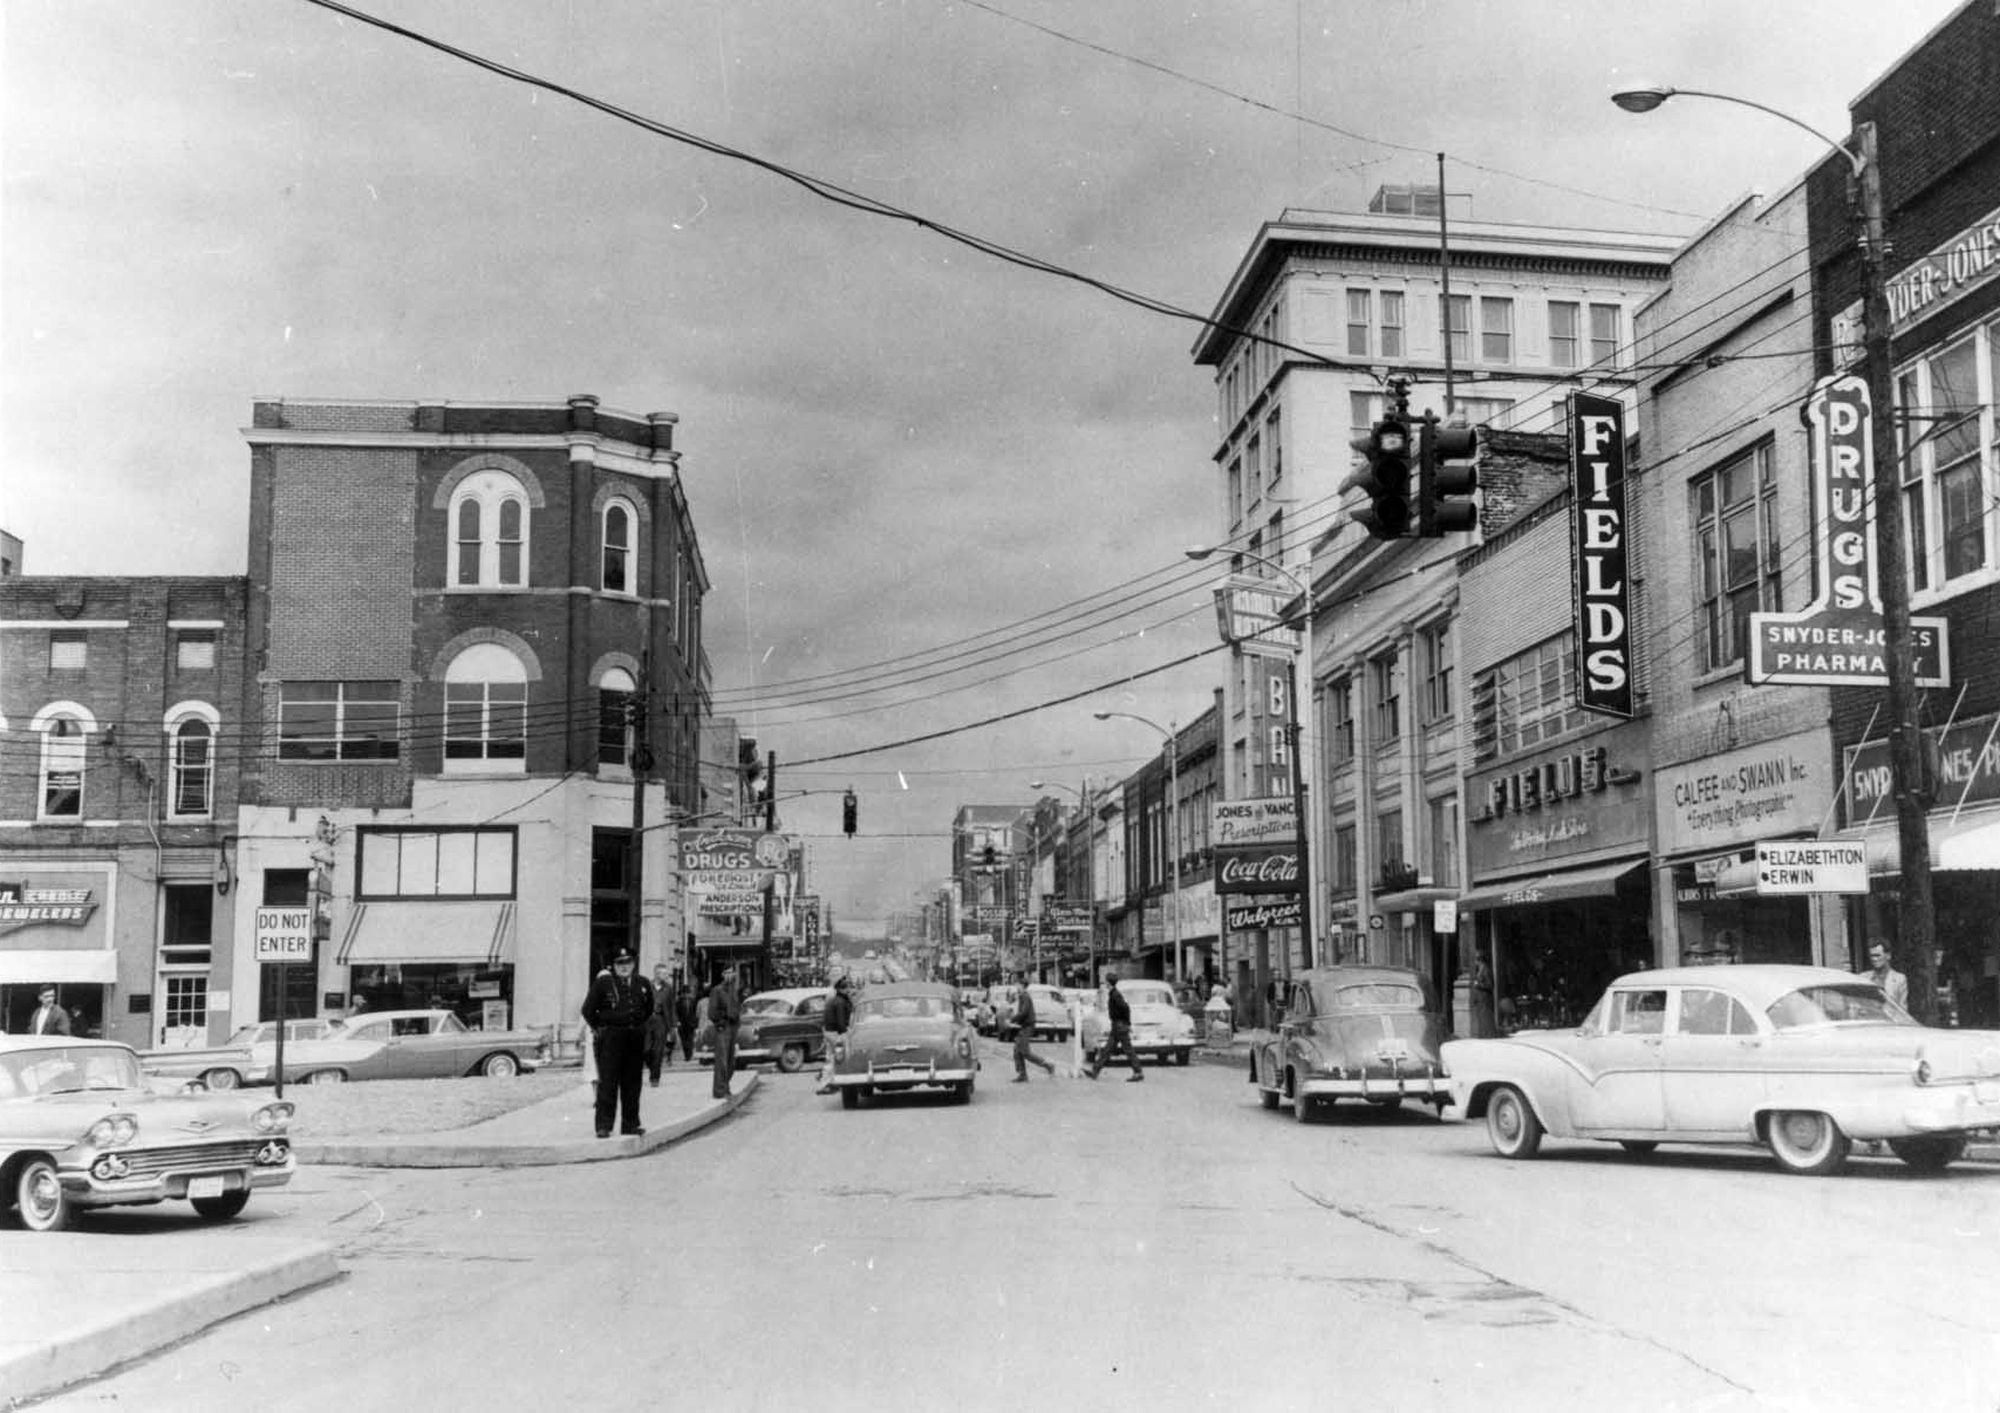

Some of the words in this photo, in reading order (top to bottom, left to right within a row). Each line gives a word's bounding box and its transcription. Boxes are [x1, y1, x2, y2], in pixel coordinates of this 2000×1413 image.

[1886, 217, 2000, 325] YDER-JONES
[1829, 402, 1864, 609] DRUGS
[1580, 415, 1627, 692] FIELDS
[1768, 627, 1932, 647] SNYDER-JOS
[1777, 653, 1923, 673] PHARMAY
[1488, 747, 1606, 819] FIELDS
[1674, 774, 1719, 807] CALFEE
[1721, 774, 1737, 791] AND
[1738, 758, 1786, 795] SWANN
[1216, 805, 1254, 819] JONES
[685, 852, 751, 870] DRUGS
[1769, 850, 1863, 867] ELIZABETHTON
[1769, 868, 1814, 885] ERWIN
[0, 907, 83, 920] EWELERS
[259, 913, 279, 929] DO
[281, 913, 308, 929] NOT
[259, 936, 307, 952] ENTER
